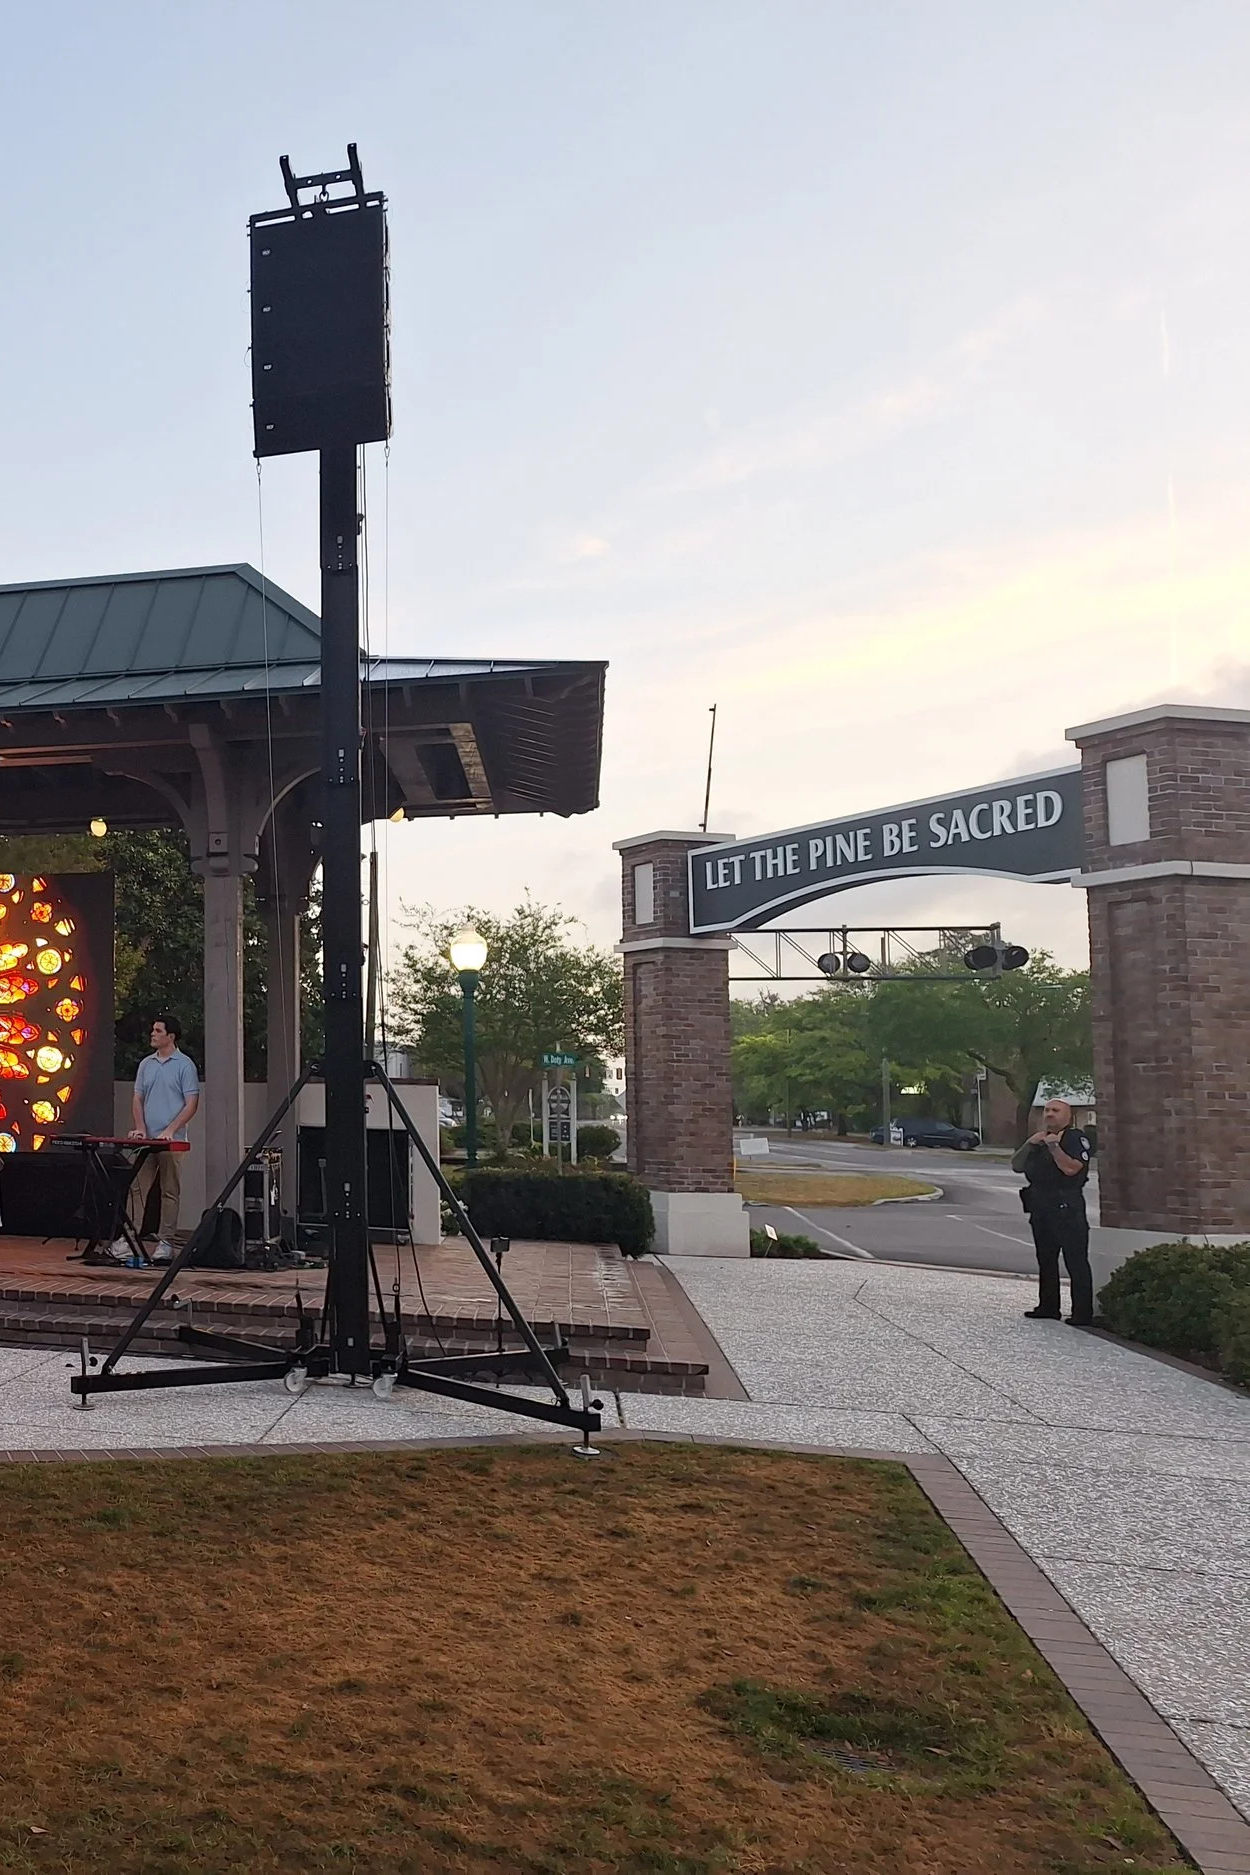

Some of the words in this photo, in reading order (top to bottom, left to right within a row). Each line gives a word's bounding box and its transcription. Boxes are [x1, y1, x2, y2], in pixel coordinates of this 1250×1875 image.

[705, 854, 746, 890] LET
[749, 843, 801, 881] THE
[808, 827, 873, 871] PINE
[881, 818, 919, 857] BE
[929, 790, 1063, 848] SACRED
